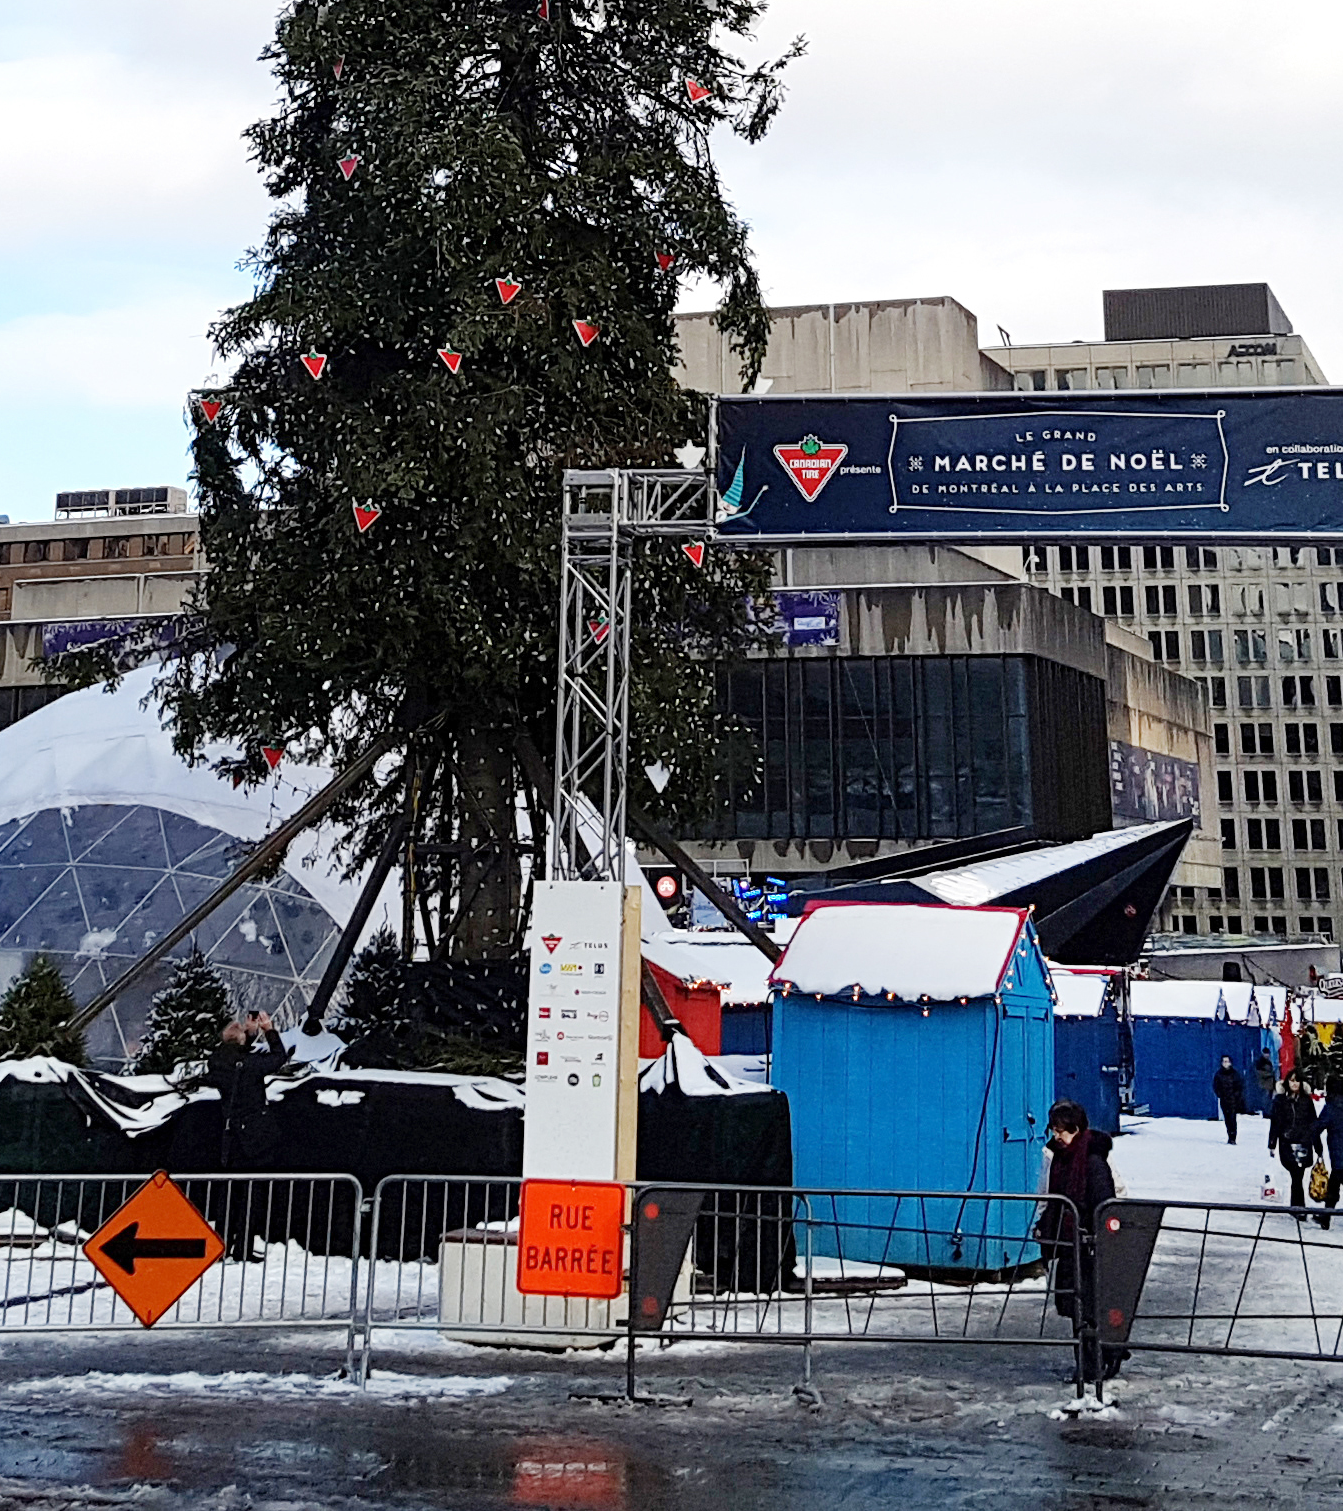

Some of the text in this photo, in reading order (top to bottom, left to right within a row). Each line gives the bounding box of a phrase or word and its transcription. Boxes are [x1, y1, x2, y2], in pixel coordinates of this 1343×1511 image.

[1015, 430, 1097, 443] LE GRAND
[1265, 446, 1279, 454] en
[789, 458, 832, 469] CANADIAN
[934, 449, 1184, 472] MARCHÉ DE NOËL
[801, 469, 820, 480] TIRE
[840, 465, 882, 476] présente
[911, 481, 1203, 494] DE MONTRÉAL À LA PLACE DES ARTS
[549, 1203, 595, 1231] RUE
[525, 1244, 615, 1275] BARRÉE
